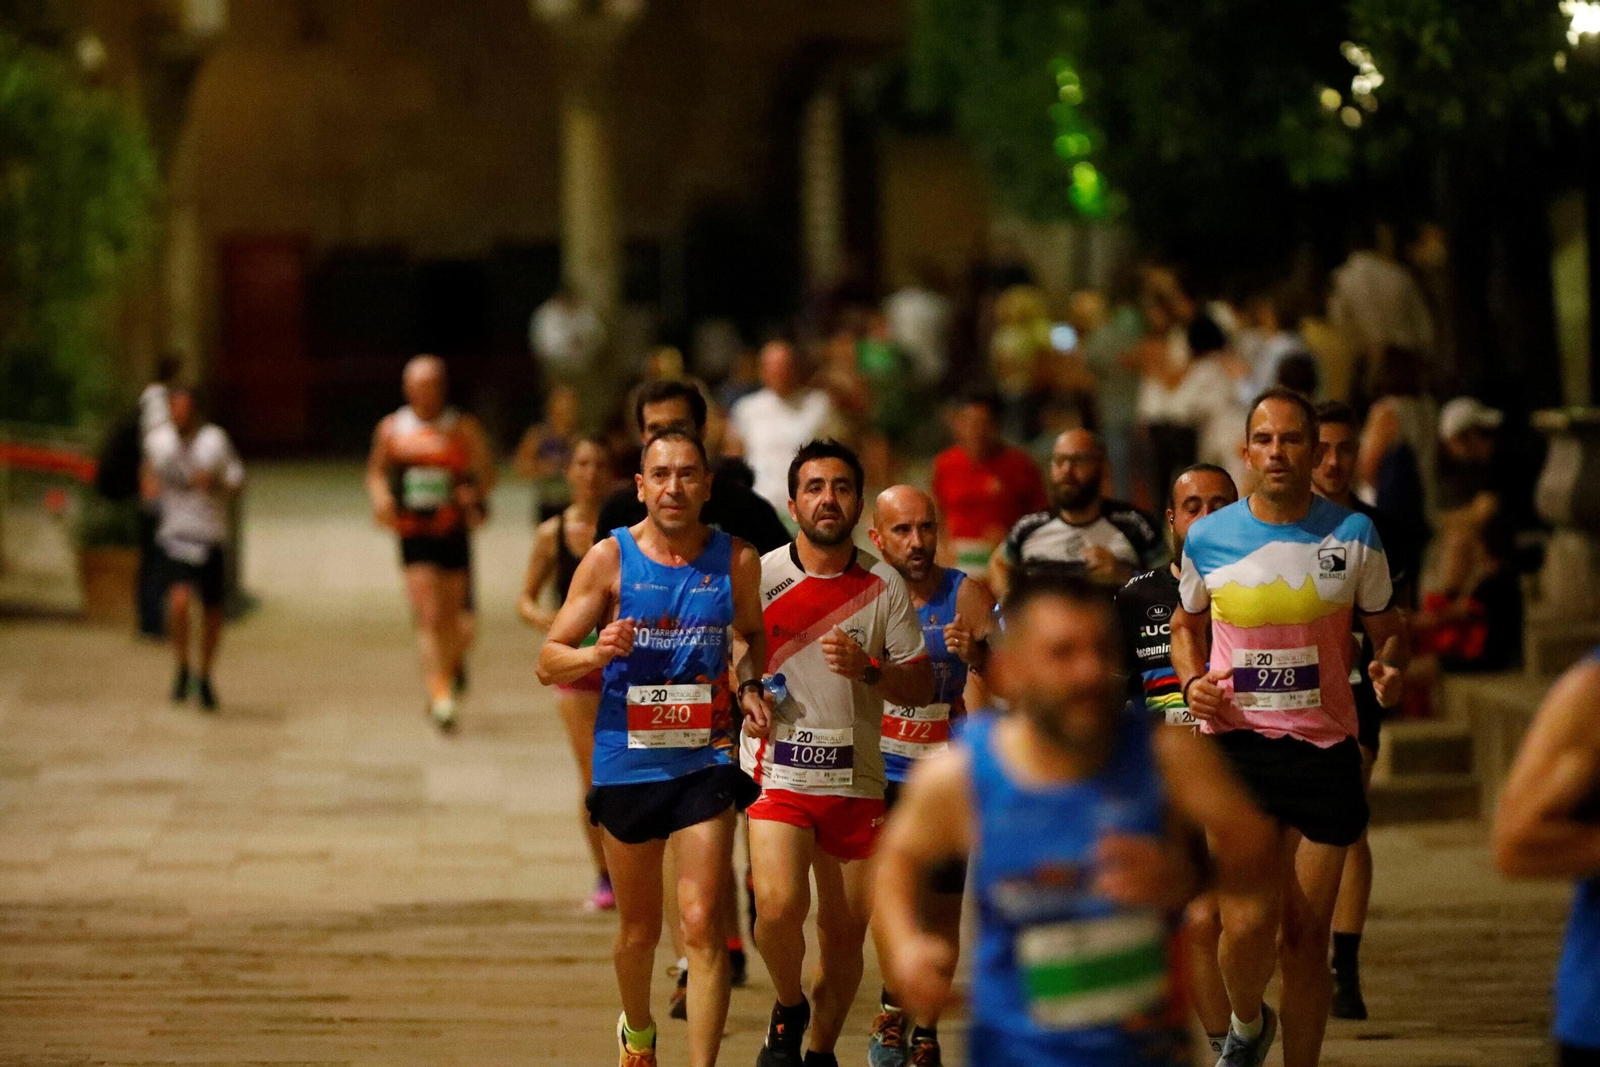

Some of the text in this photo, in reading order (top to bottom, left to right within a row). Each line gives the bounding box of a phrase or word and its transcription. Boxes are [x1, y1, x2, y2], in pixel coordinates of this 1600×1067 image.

[650, 625, 723, 637] CARRERA NOCTURNA
[650, 634, 722, 649] TROTACALLES
[1257, 653, 1273, 666] 20
[1257, 668, 1296, 687] 978
[651, 689, 668, 702] 20
[651, 705, 691, 724] 240
[900, 706, 916, 718] 20
[898, 720, 932, 738] 172
[797, 731, 813, 744] 20
[790, 745, 838, 764] 1084
